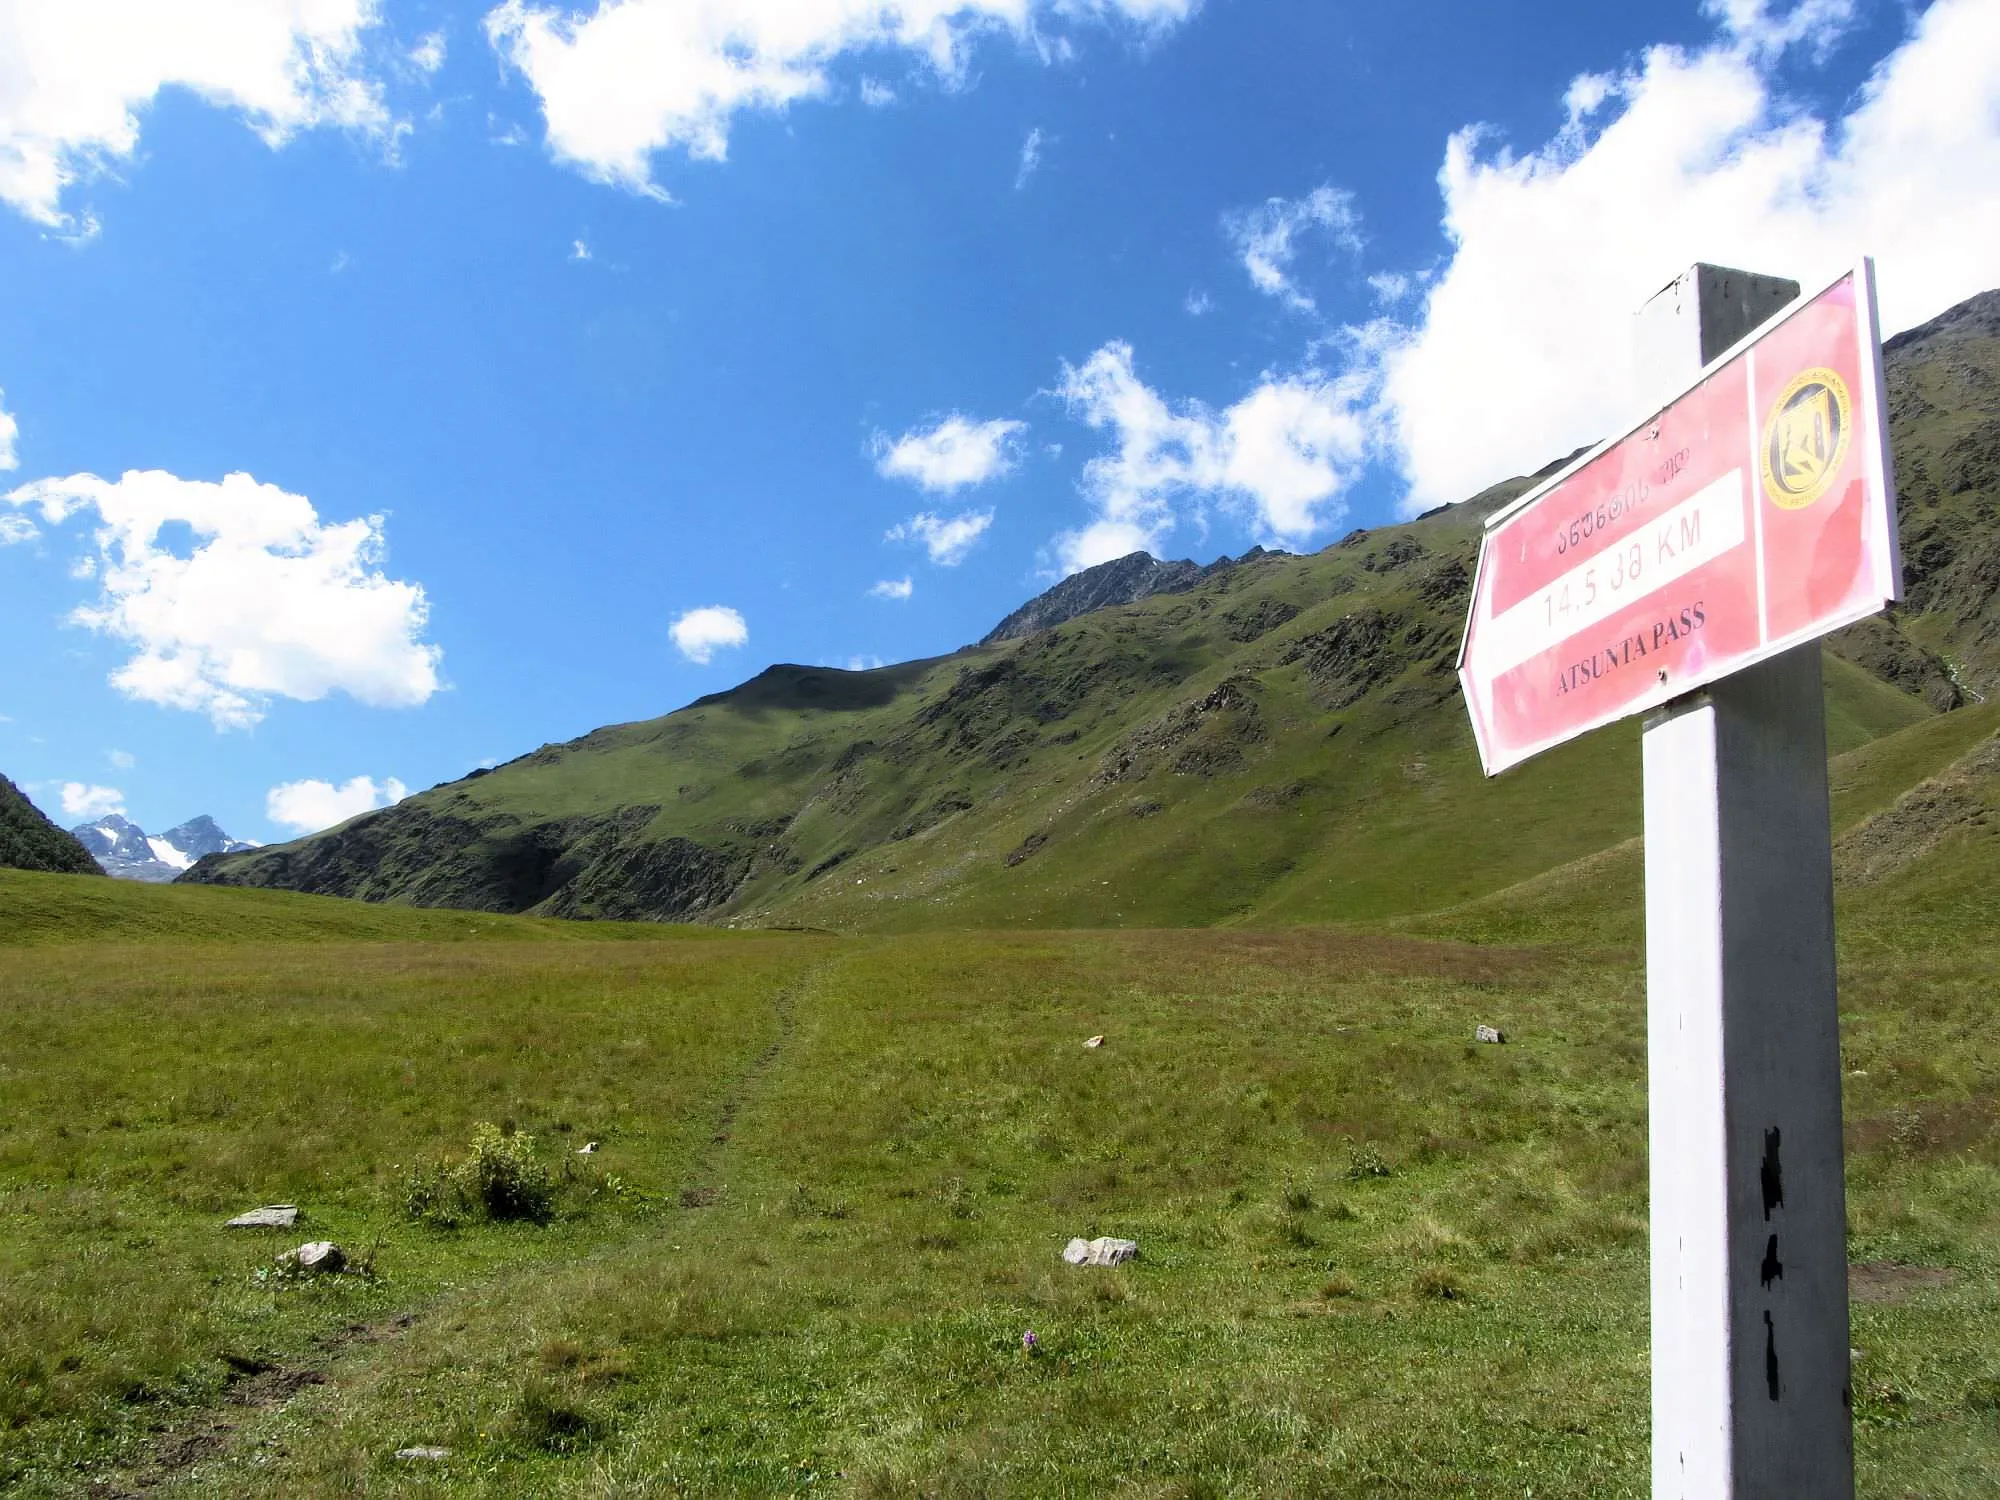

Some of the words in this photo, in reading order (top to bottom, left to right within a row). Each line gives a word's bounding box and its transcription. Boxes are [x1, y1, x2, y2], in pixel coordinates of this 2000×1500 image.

[1544, 568, 1597, 627] 14.5
[1658, 508, 1701, 565] KM
[1556, 633, 1647, 697] ATSUNTA
[1651, 601, 1705, 650] PASS
